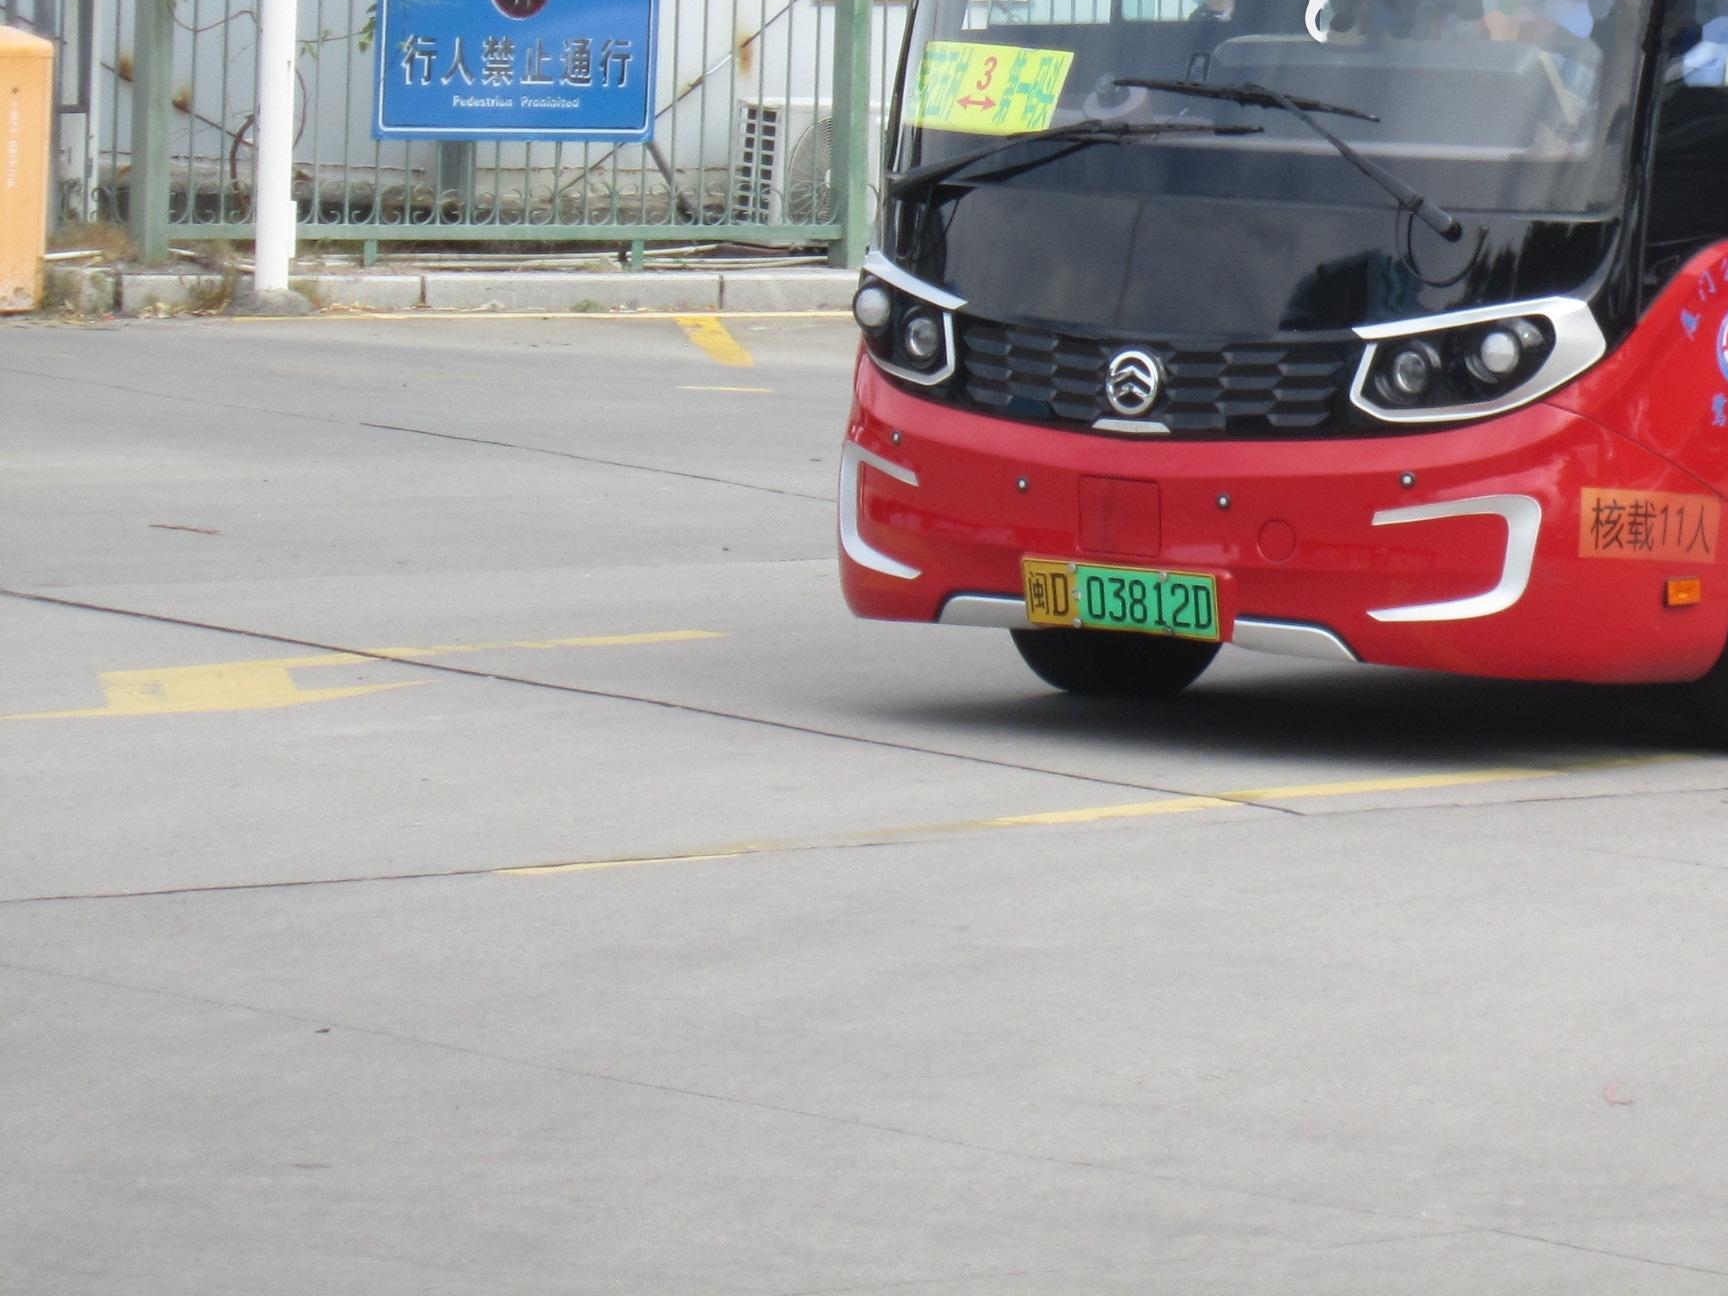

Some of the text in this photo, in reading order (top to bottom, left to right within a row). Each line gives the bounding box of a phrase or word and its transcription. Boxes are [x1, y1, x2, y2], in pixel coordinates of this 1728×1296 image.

[400, 34, 633, 88] 行人禁止通行
[975, 56, 999, 91] 3
[452, 95, 581, 109] Pedestrian Prohibited
[1590, 497, 1711, 555] 核载11人
